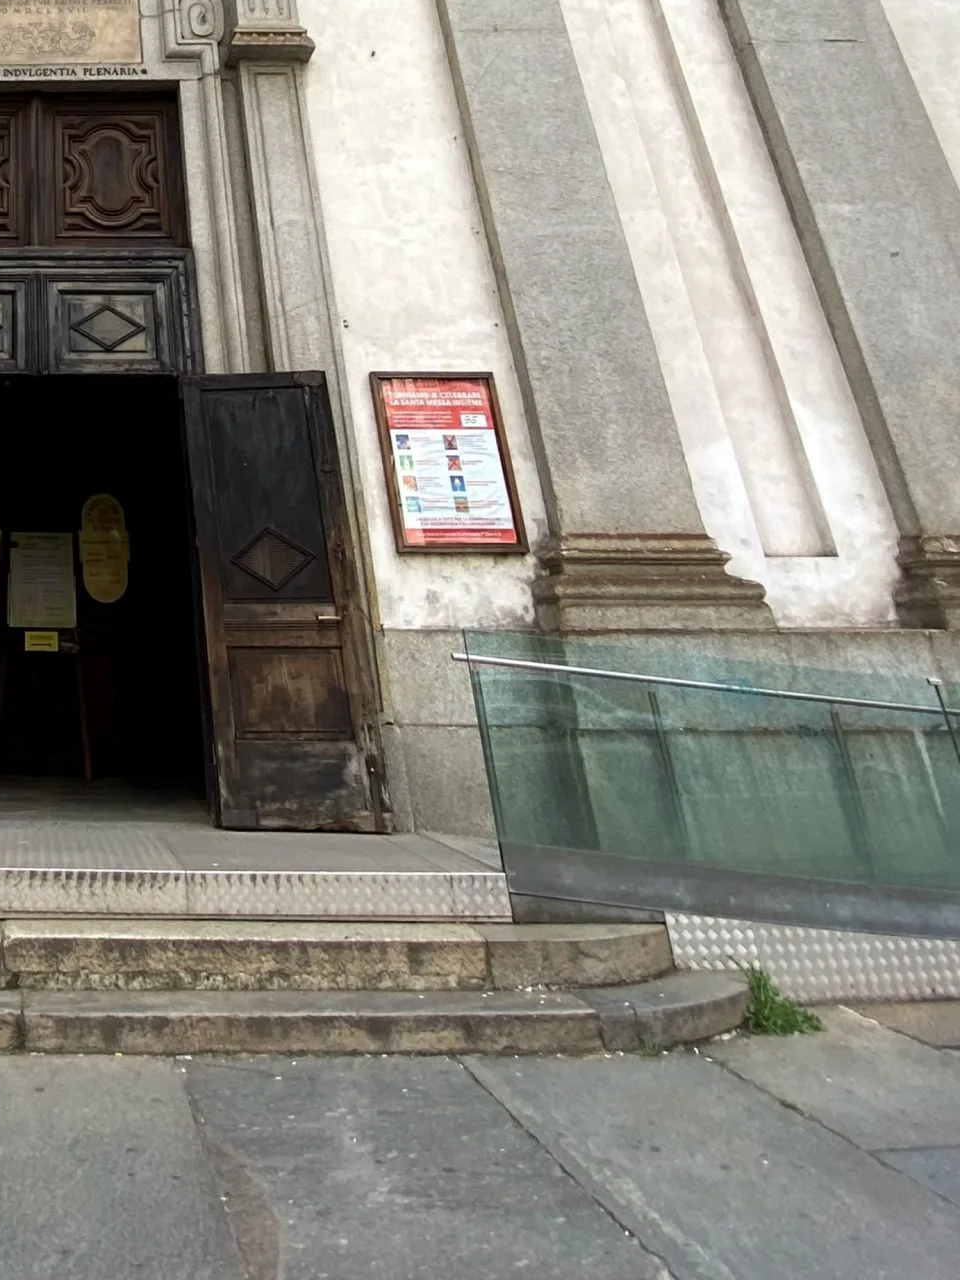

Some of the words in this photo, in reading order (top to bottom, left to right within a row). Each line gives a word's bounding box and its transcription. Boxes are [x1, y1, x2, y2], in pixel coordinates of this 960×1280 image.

[3, 67, 78, 78] INDVLGENTIA
[82, 67, 139, 77] PLENARIA
[390, 398, 400, 407] LA
[400, 398, 426, 407] SANTA
[426, 398, 452, 407] MESSA
[452, 398, 484, 407] INSIEME
